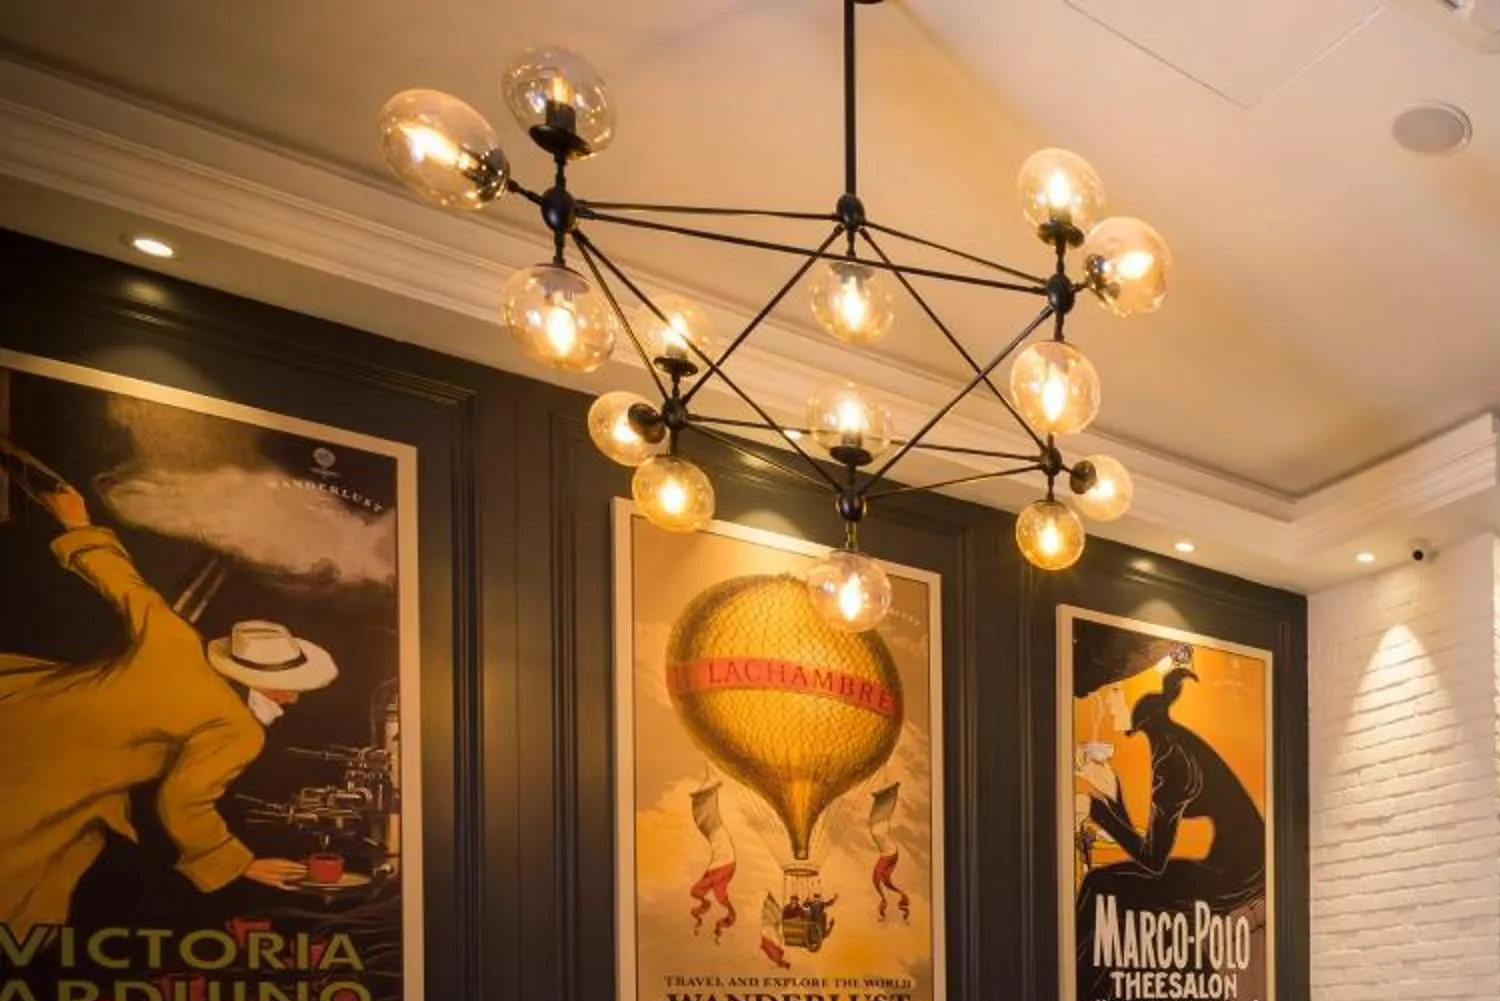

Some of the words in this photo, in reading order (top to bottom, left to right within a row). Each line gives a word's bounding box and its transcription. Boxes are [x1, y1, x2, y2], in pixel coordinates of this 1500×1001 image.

[708, 661, 894, 708] LACHAMBRE
[0, 925, 366, 971] VICTORIA
[664, 975, 725, 988] TRAVEL
[727, 977, 759, 988] AND
[834, 977, 858, 989] THE
[863, 977, 912, 989] WORLD
[1110, 970, 1238, 1001] THEESALON
